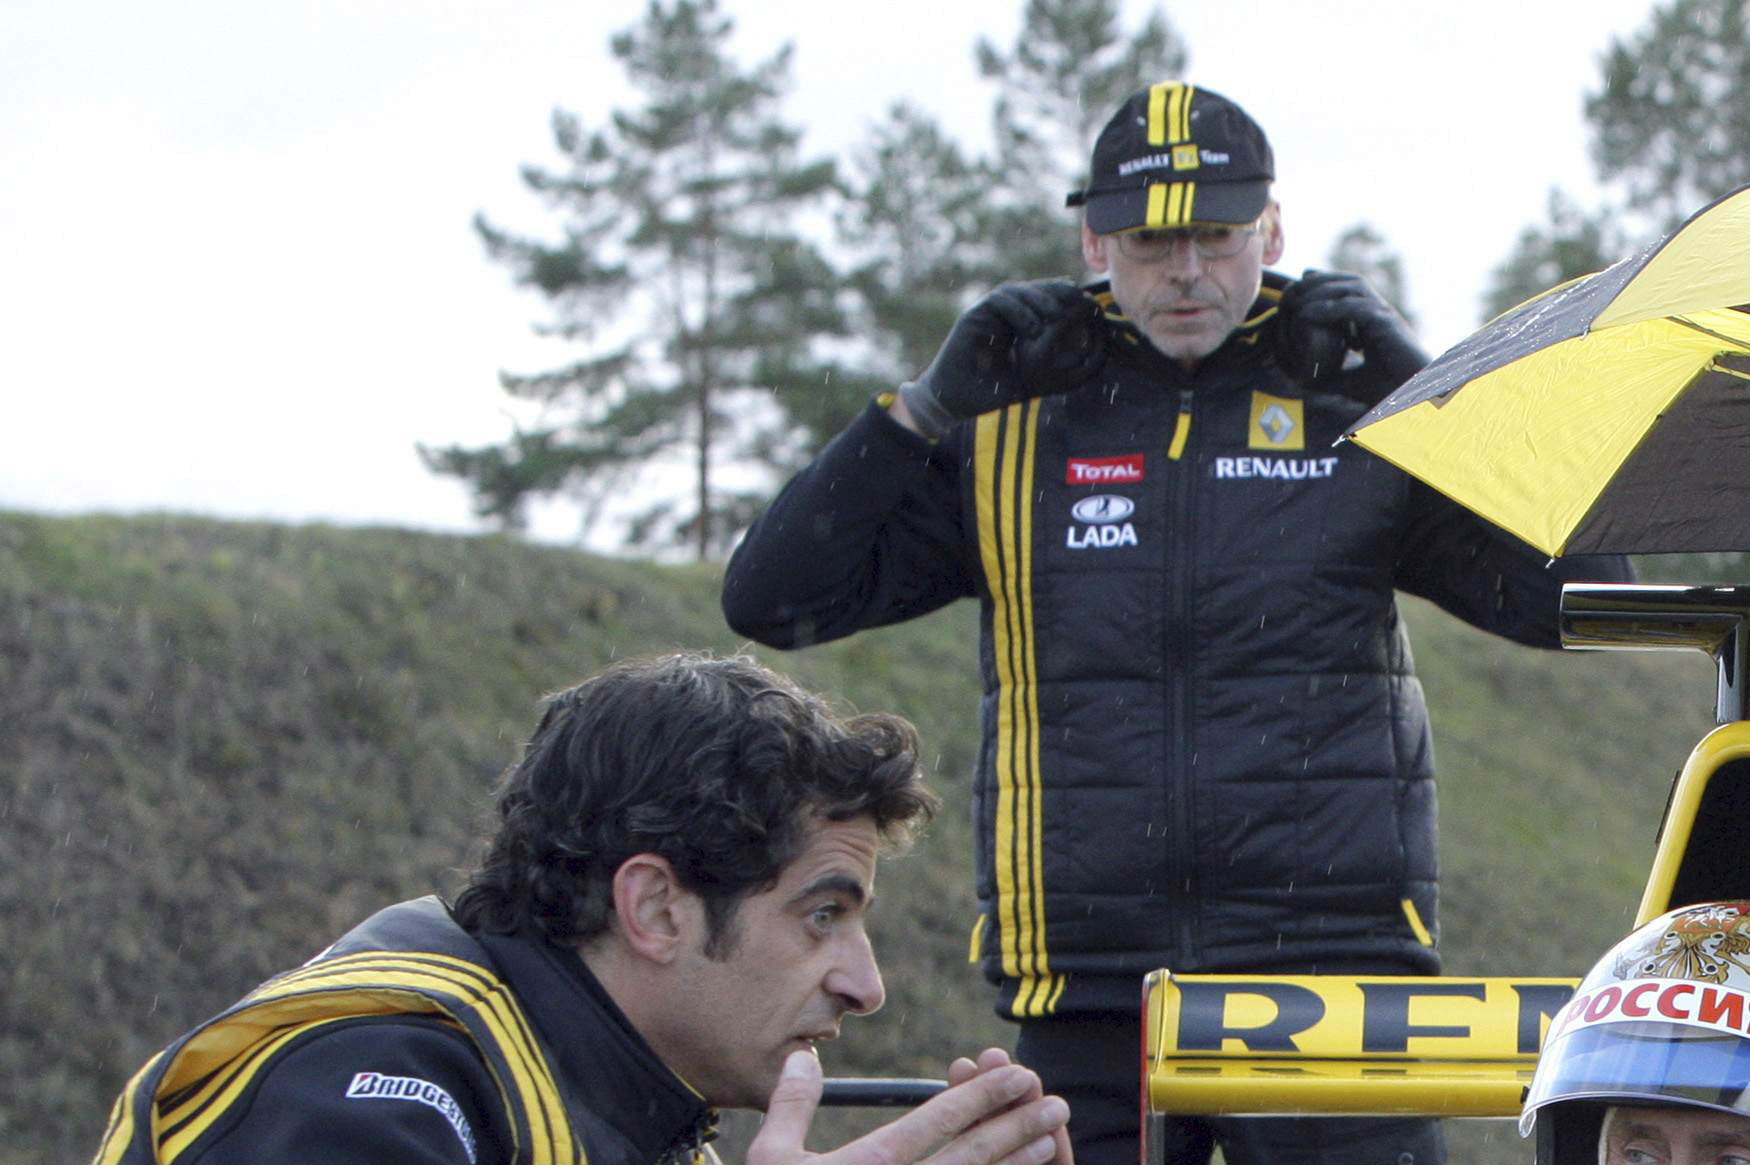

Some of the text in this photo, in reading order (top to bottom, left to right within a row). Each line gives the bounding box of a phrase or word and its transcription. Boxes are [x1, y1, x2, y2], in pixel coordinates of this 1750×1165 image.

[1071, 462, 1141, 480] TOTAL
[1216, 457, 1339, 479] RENAULT
[1066, 522, 1138, 549] LADA
